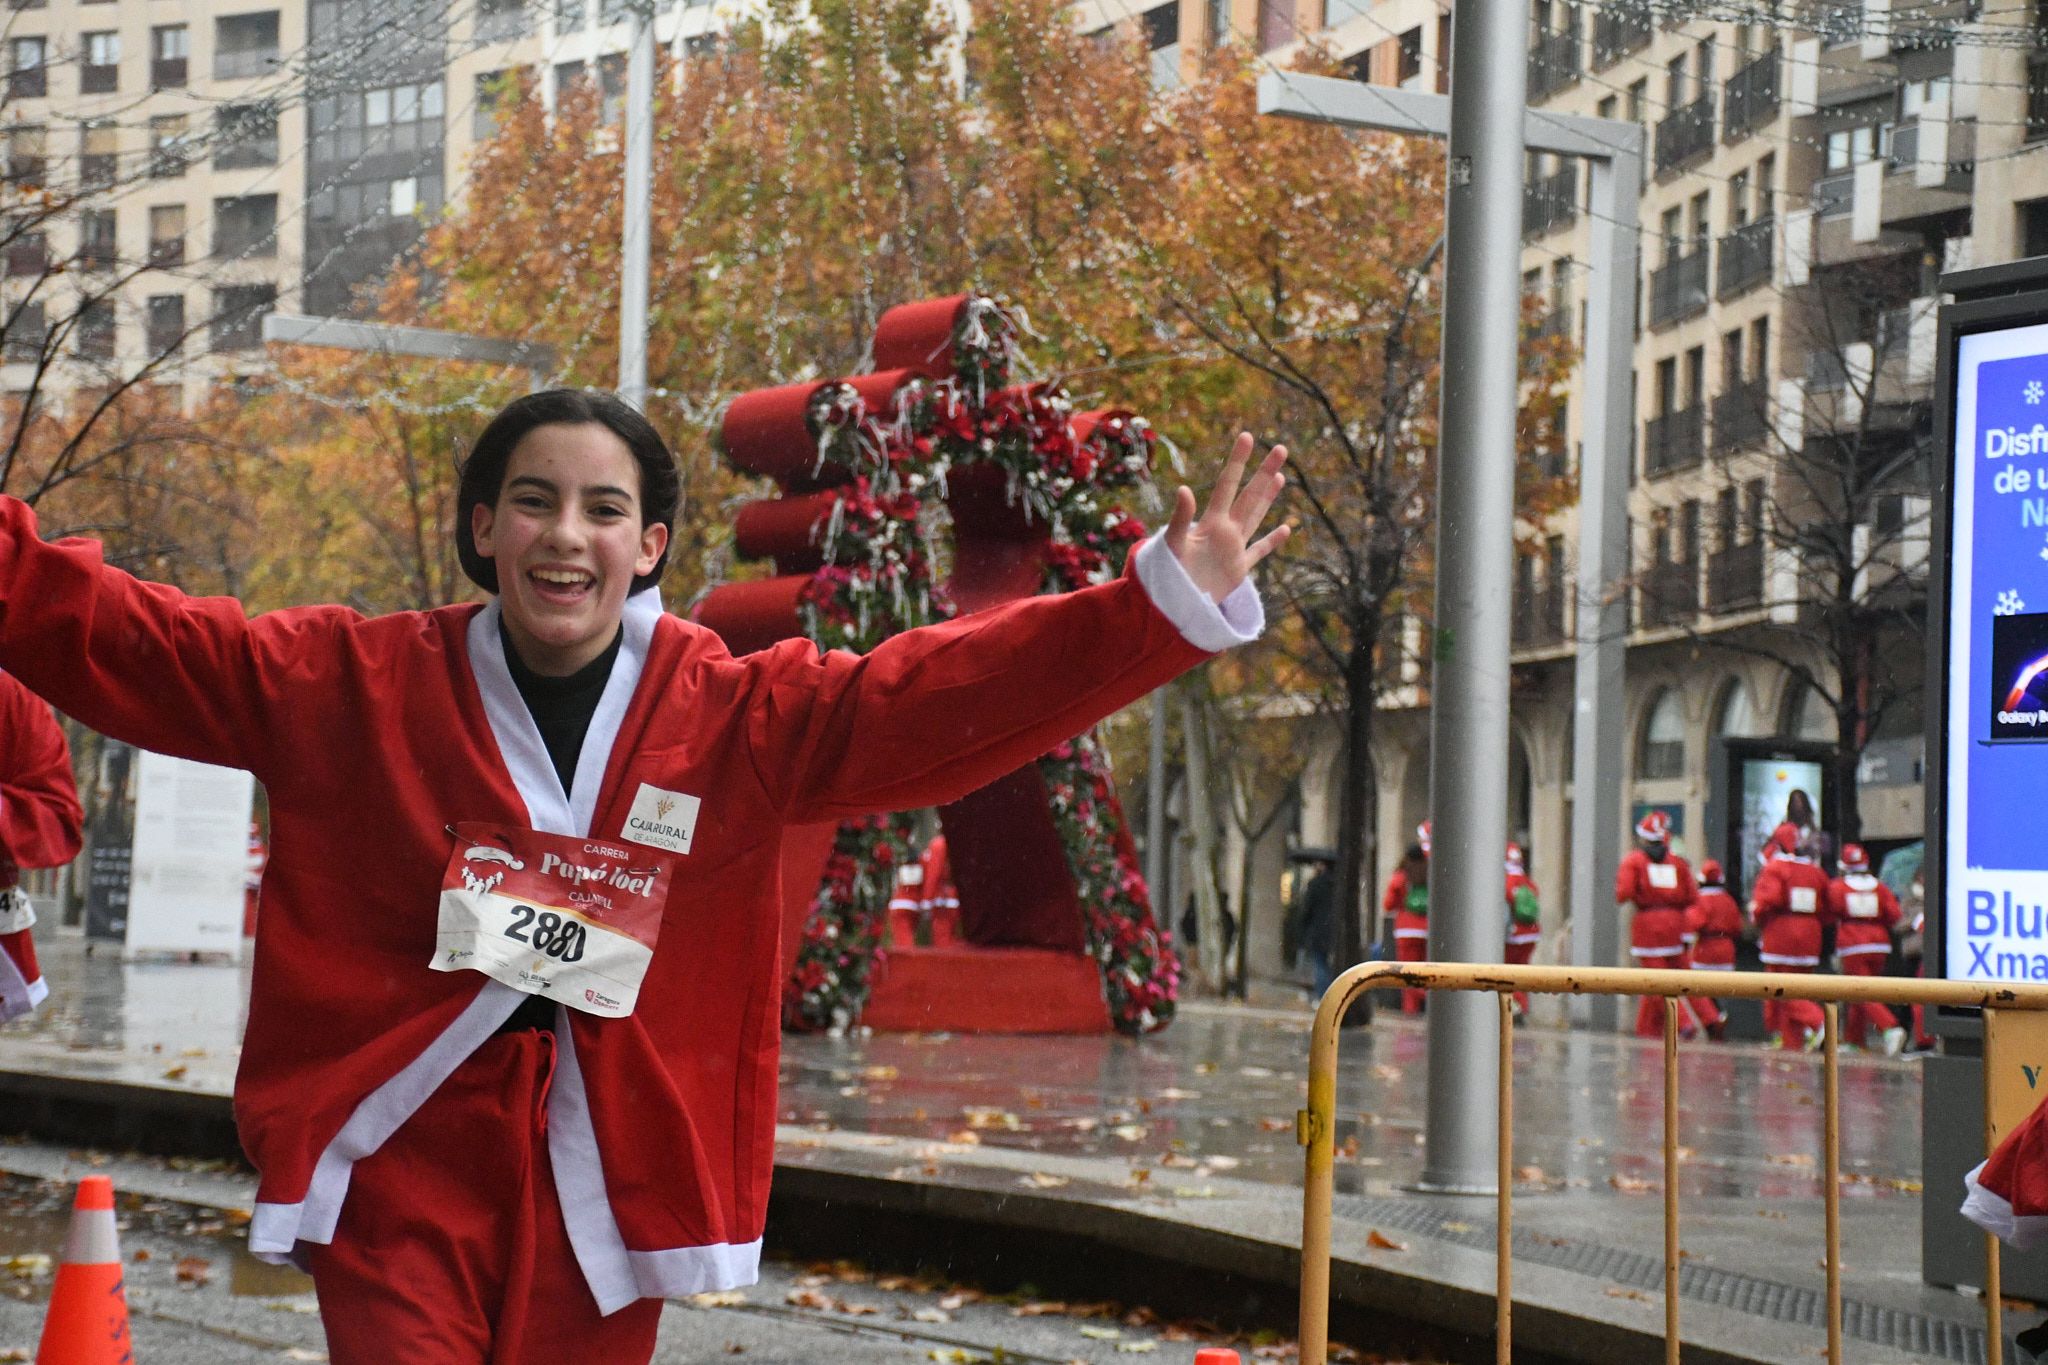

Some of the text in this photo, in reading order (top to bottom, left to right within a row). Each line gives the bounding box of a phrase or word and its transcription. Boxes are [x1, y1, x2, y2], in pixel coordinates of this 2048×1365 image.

[1994, 464, 2031, 494] de
[2022, 498, 2048, 528] N
[1997, 710, 2038, 727] Galaxy
[583, 844, 629, 861] CARRERA
[539, 852, 607, 886] Papá
[1967, 890, 2048, 939] Blu
[504, 905, 586, 962] 2880
